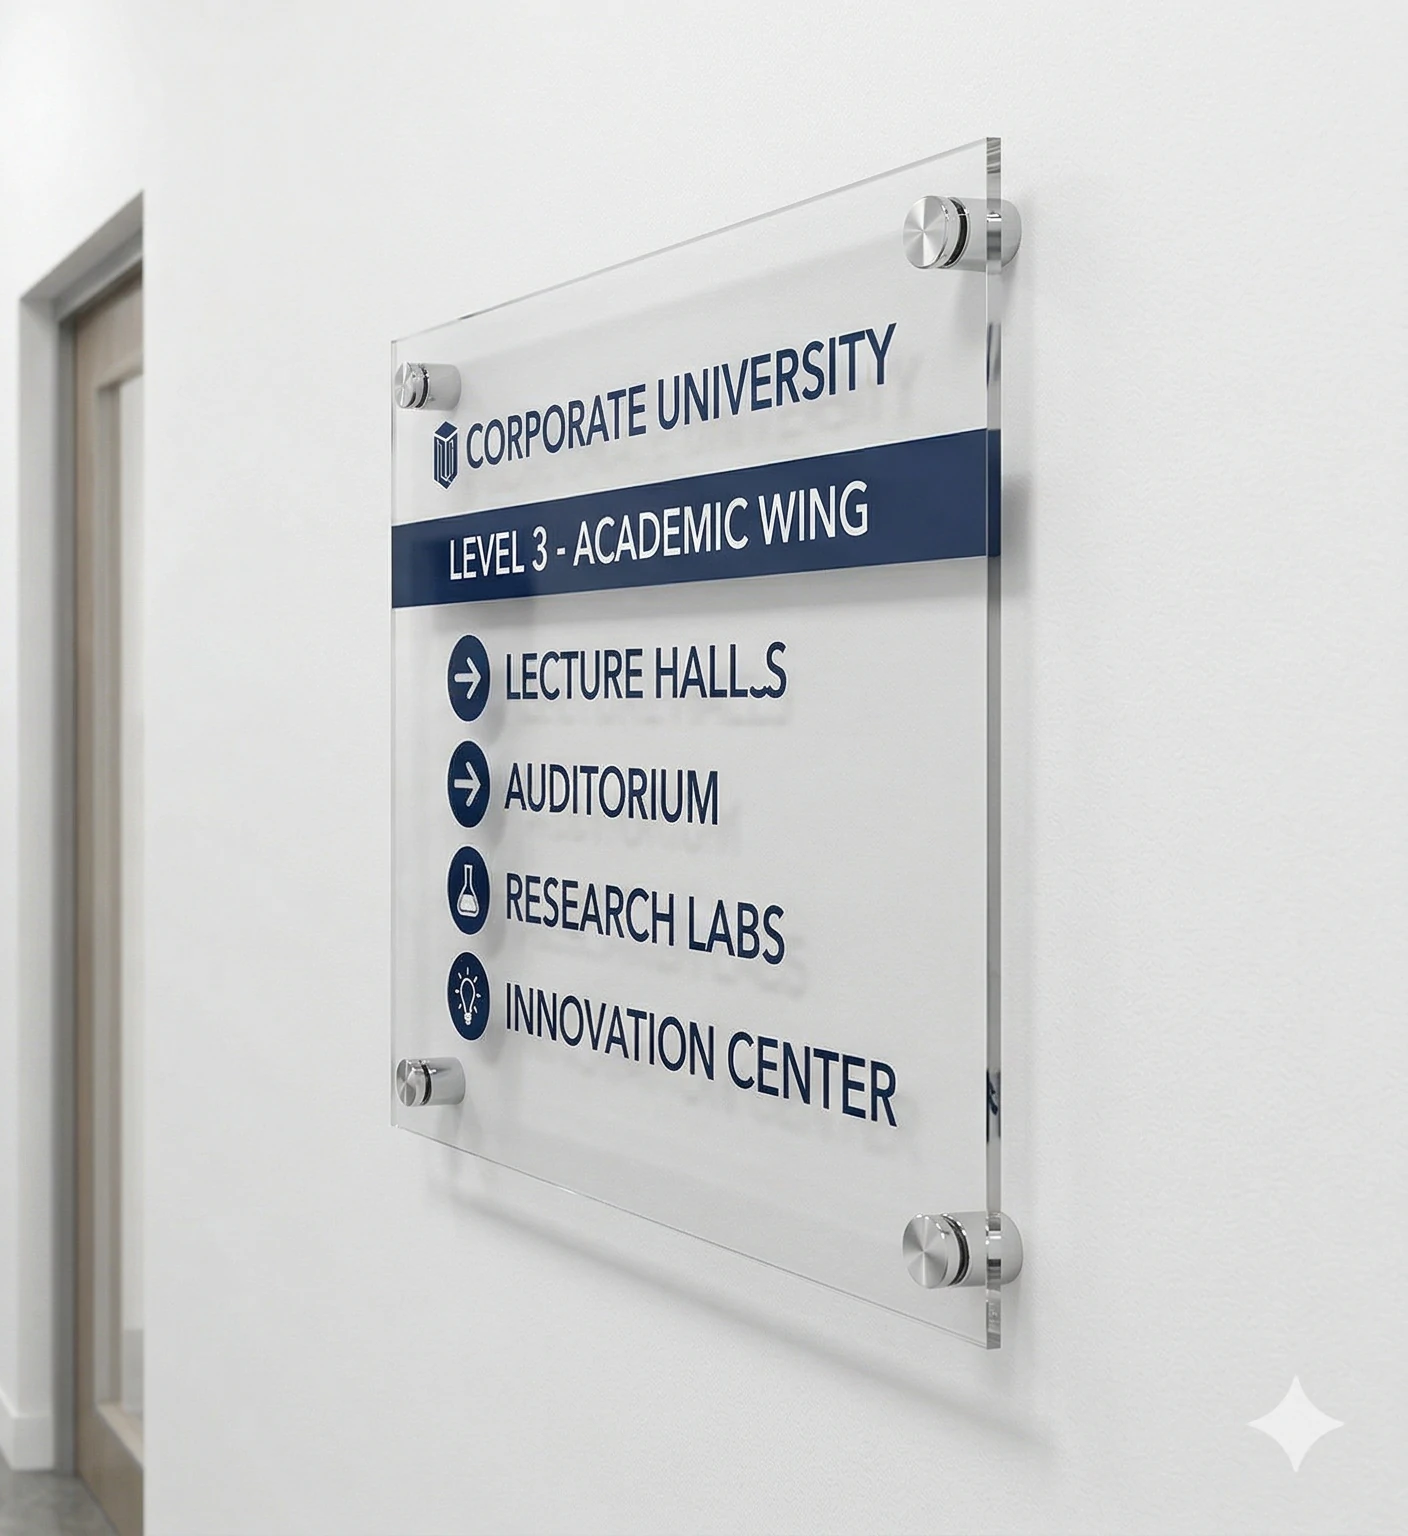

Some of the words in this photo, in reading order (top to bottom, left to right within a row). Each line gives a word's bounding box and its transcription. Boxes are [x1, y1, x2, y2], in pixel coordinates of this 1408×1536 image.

[466, 383, 647, 469] CORPORATE
[658, 322, 897, 431] UNIVERSITY
[449, 530, 525, 581] LEVEL
[532, 526, 548, 572] 3
[556, 547, 566, 556] -
[572, 502, 749, 567] ACADEMIC
[758, 480, 868, 545] WING
[506, 648, 644, 701] LECTURE
[503, 762, 718, 826] AUDITORIUM
[506, 872, 675, 947] RESEARCH
[688, 895, 785, 965] LABS
[506, 982, 715, 1081] INNOVATION
[727, 1031, 898, 1128] CENTER
